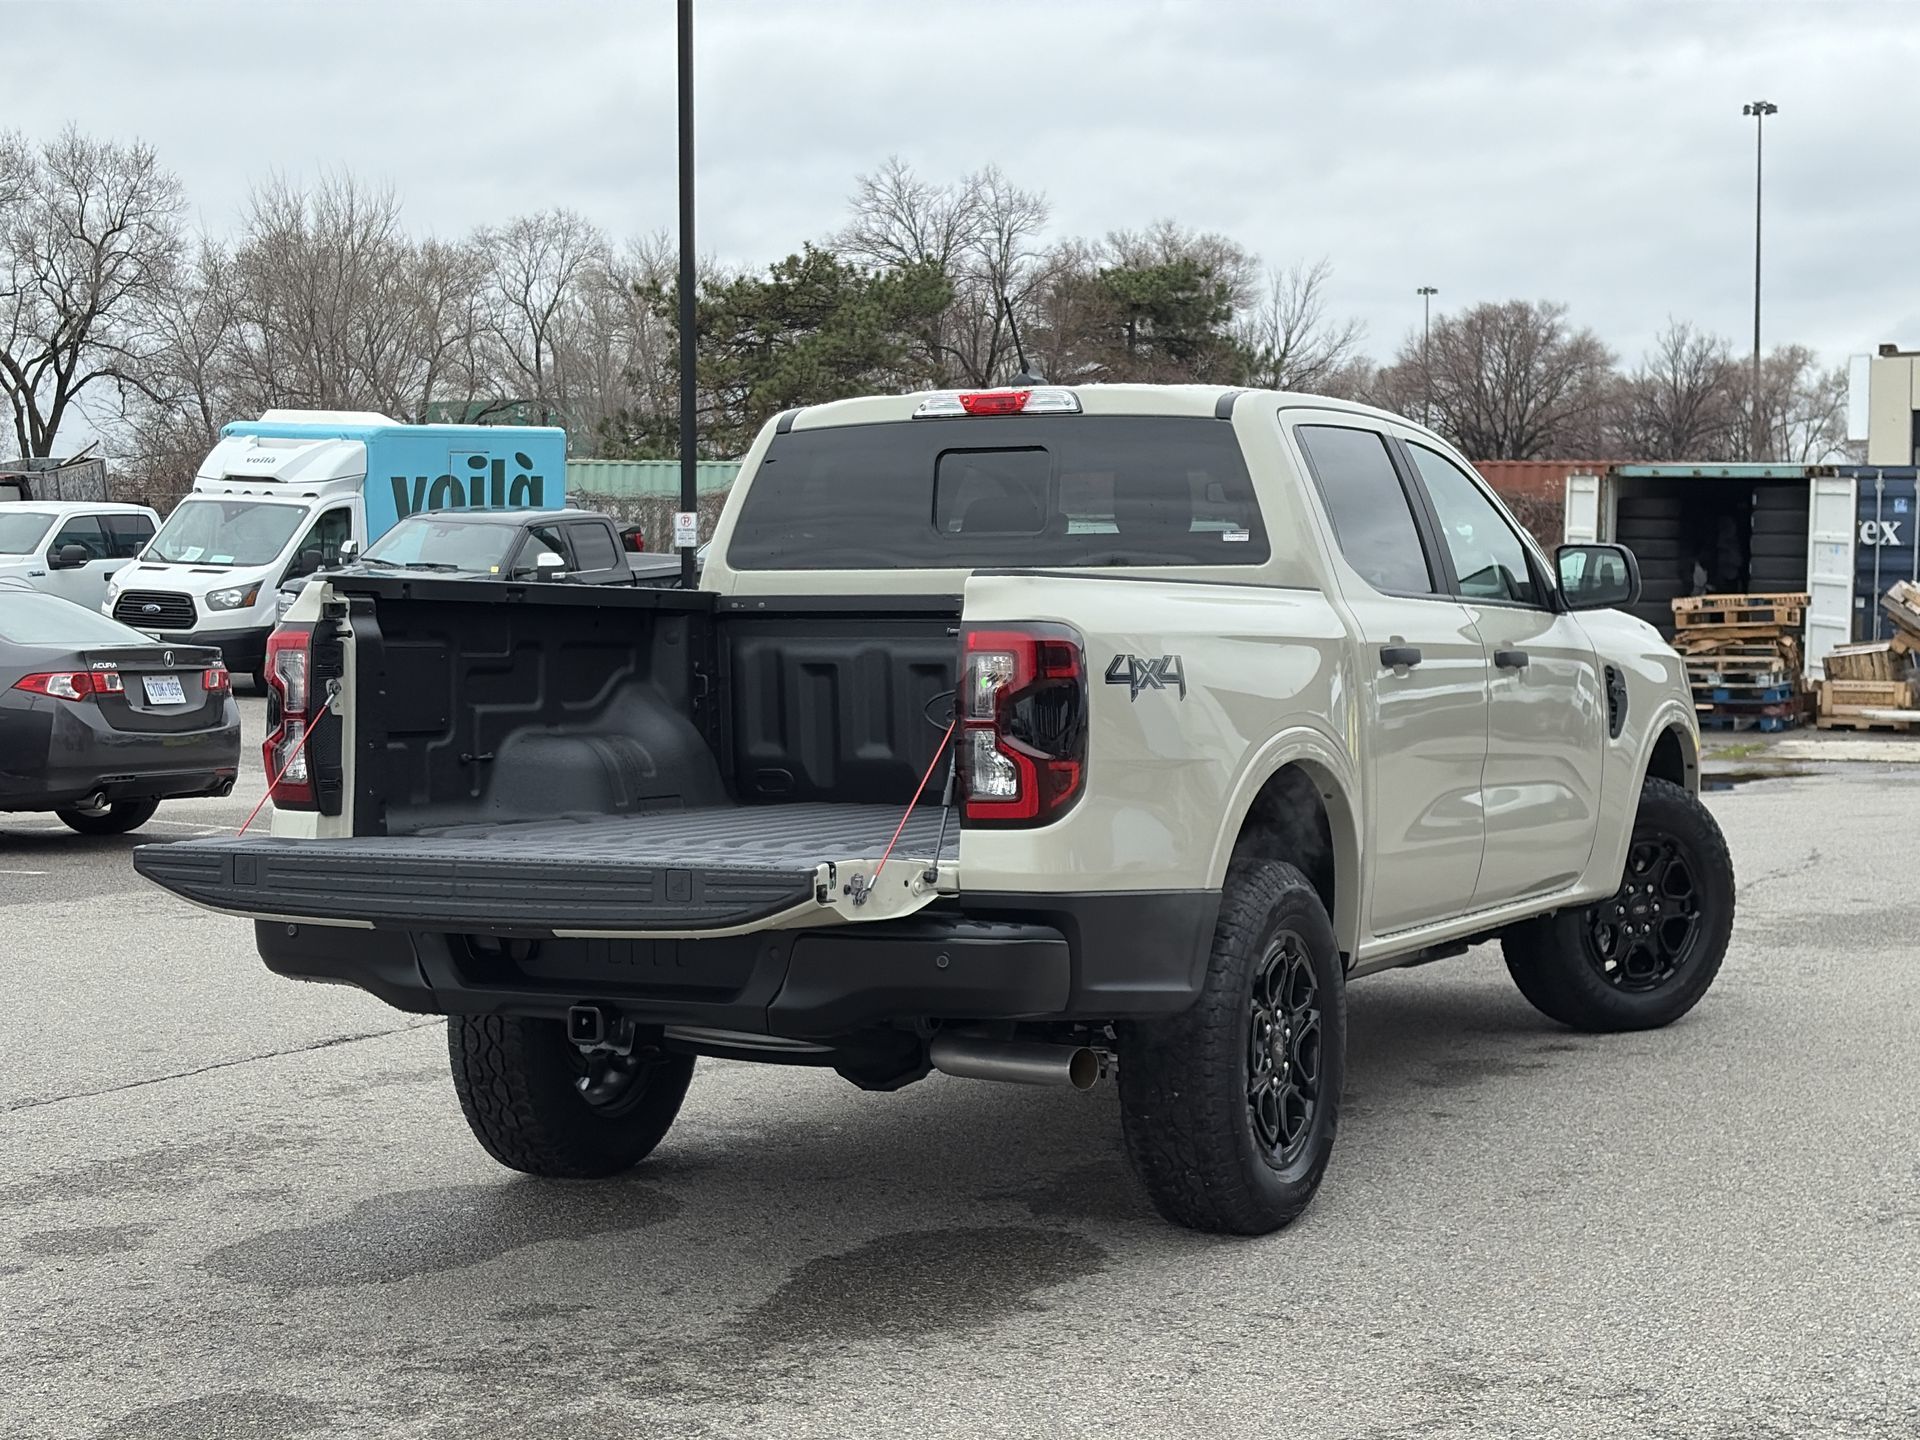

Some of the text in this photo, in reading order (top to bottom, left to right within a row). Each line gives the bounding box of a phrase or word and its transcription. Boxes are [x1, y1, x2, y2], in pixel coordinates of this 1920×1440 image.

[246, 456, 276, 464] voilà
[391, 452, 544, 521] voilà
[1858, 520, 1902, 546] ex
